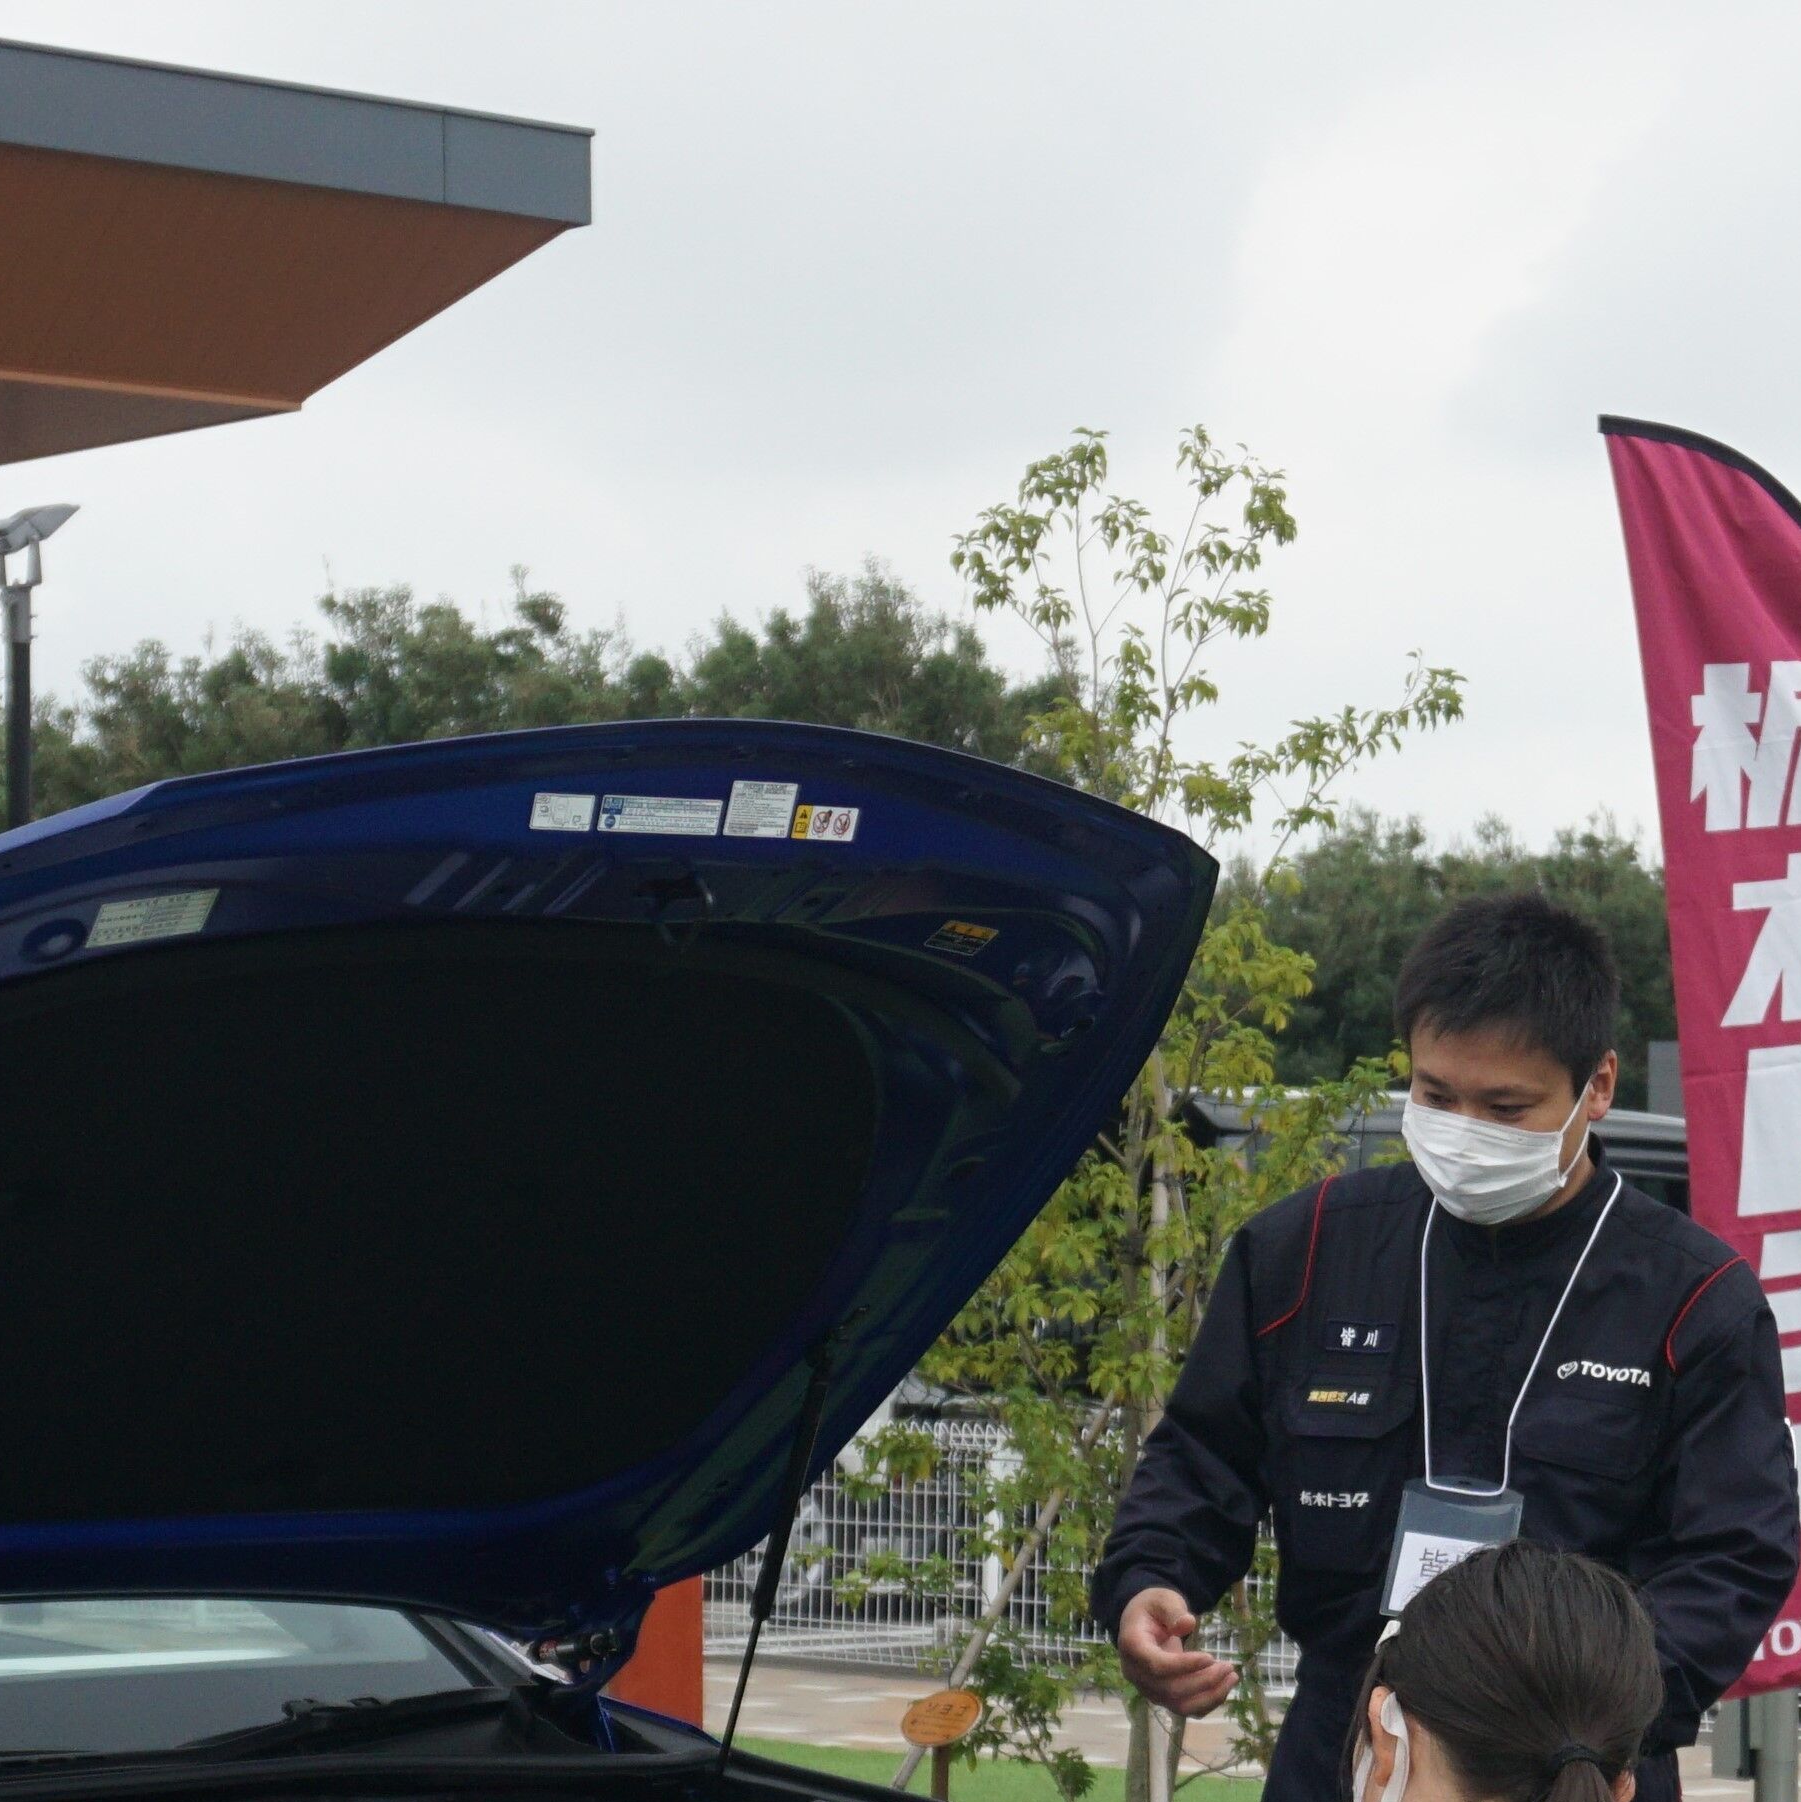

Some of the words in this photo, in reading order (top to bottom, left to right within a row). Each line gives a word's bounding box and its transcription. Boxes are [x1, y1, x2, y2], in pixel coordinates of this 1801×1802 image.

[1581, 1360, 1651, 1388] TOYOTA
[1300, 1490, 1370, 1508] 栃木トヨタ
